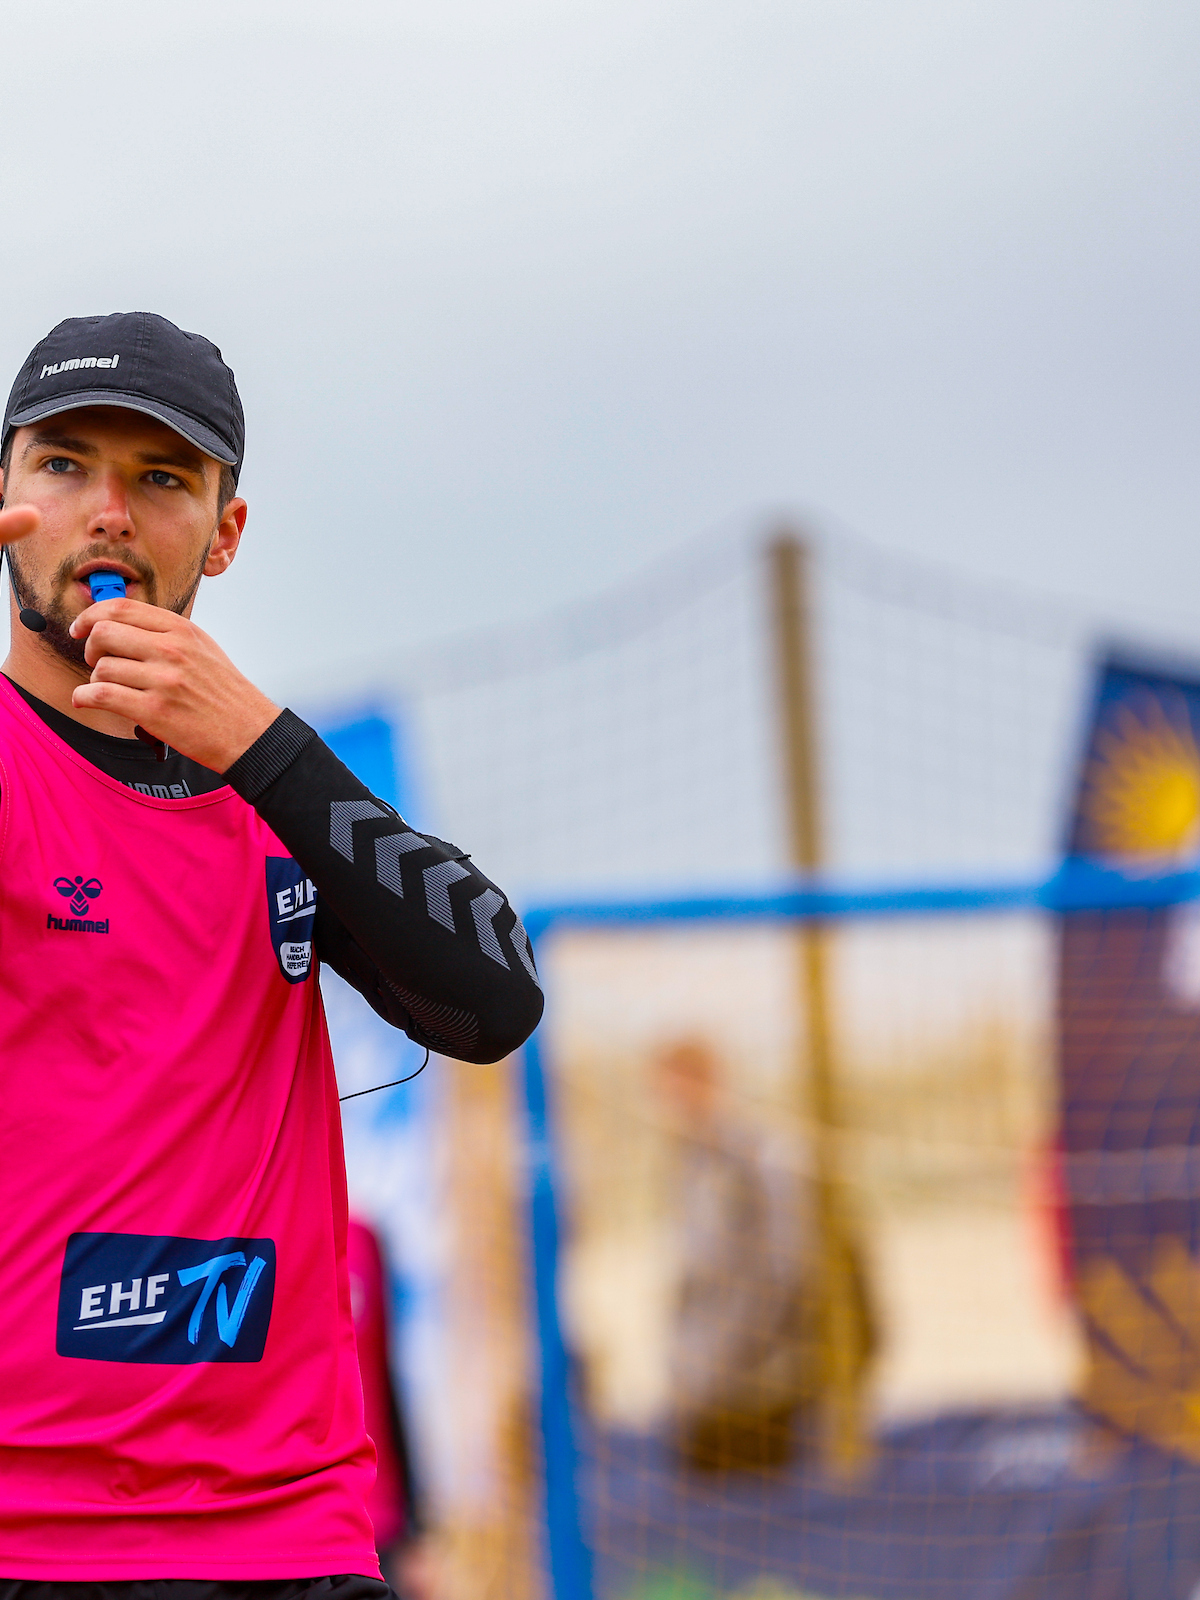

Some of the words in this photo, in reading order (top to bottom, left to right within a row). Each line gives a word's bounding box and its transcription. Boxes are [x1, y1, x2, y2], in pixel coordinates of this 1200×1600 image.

[39, 354, 120, 380] hummel
[118, 778, 192, 799] mmel
[46, 913, 109, 934] hummel
[79, 1273, 170, 1321] EHF
[177, 1251, 267, 1348] TV
